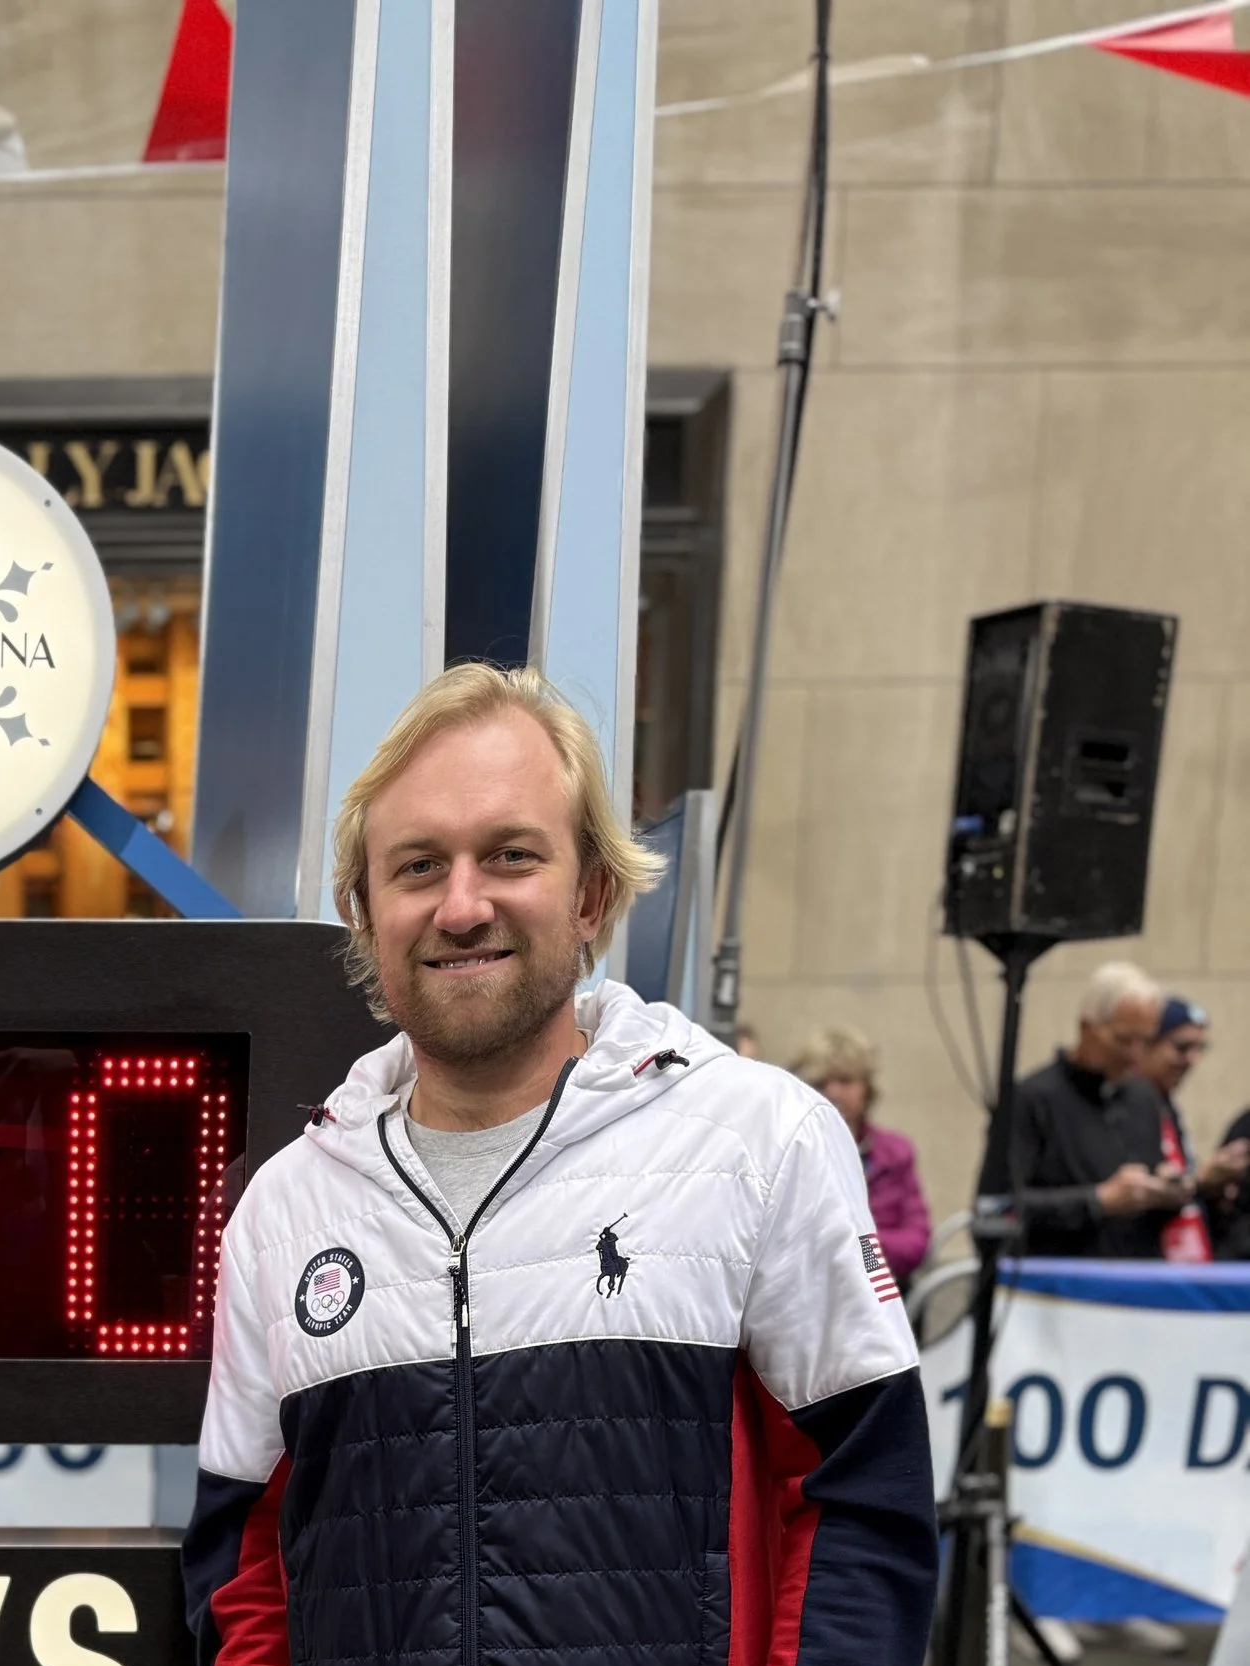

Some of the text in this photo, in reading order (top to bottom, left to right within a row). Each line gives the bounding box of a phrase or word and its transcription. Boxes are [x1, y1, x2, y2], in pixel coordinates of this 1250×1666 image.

[304, 1253, 353, 1282] UNITED STATES
[334, 1303, 353, 1324] TEAM
